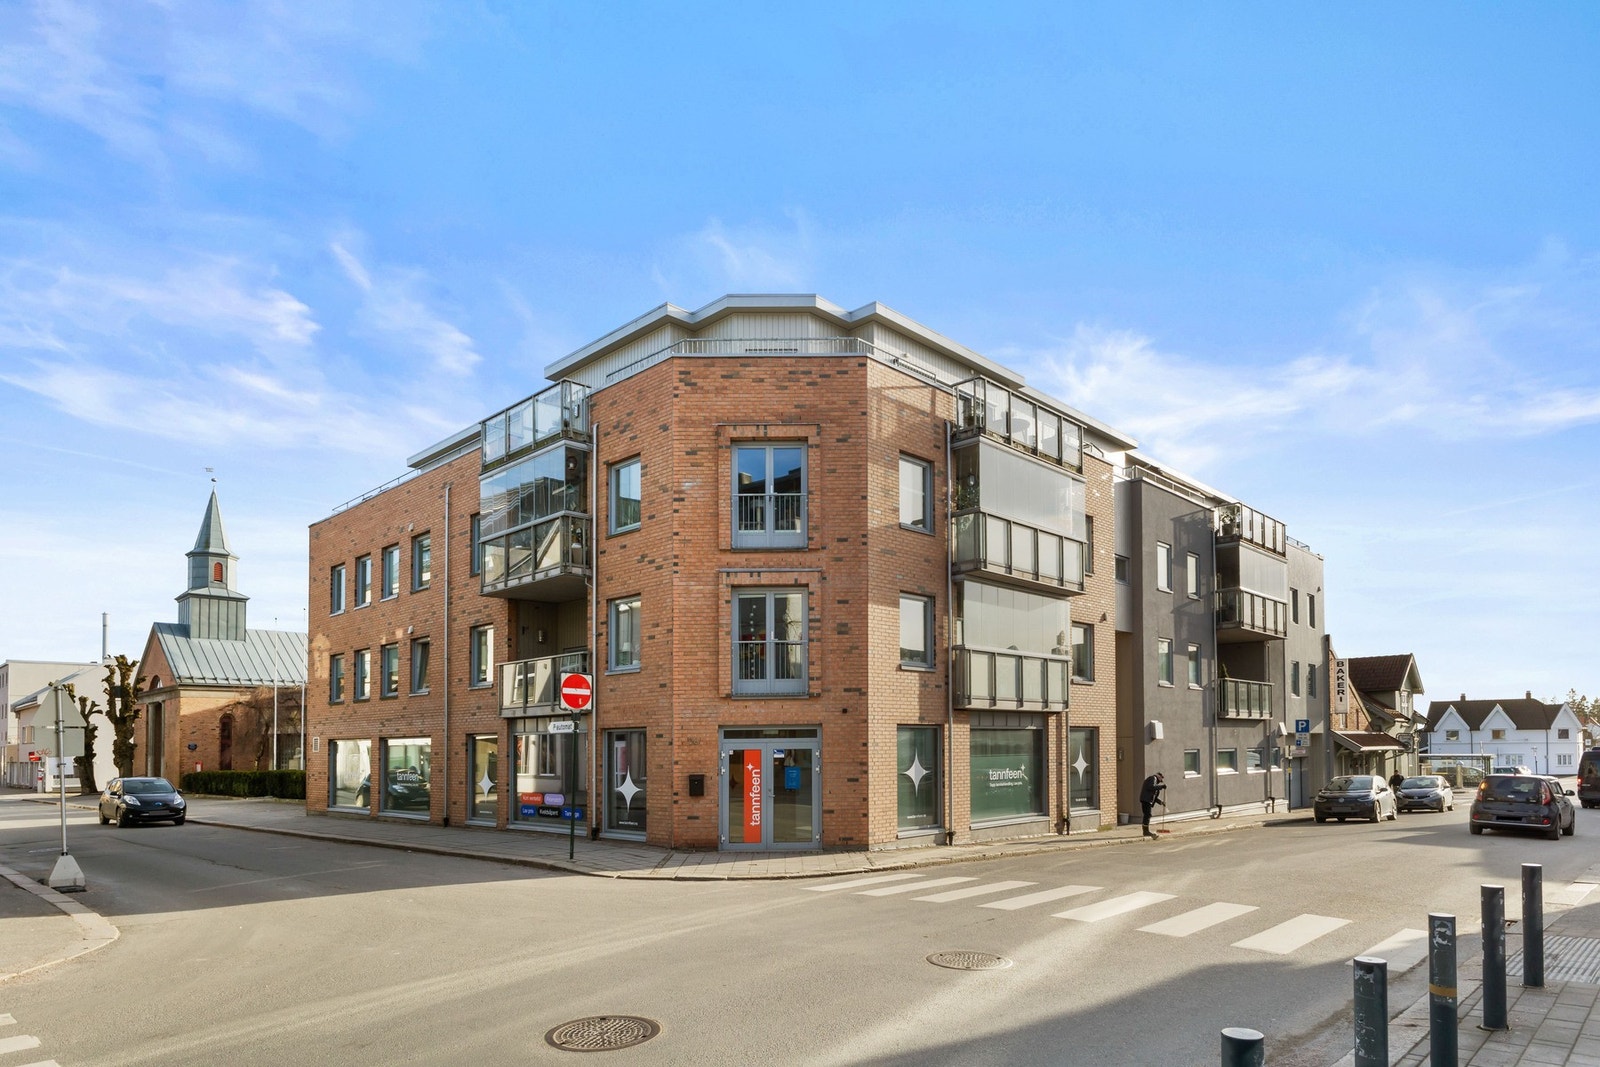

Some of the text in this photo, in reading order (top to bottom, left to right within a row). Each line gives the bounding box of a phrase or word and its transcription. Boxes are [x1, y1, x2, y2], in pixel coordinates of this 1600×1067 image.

[1336, 660, 1345, 703] BAKERI
[1298, 720, 1307, 732] P
[396, 772, 419, 782] tannfeen
[989, 767, 1023, 781] tannfeen
[749, 769, 761, 827] tannfeen
